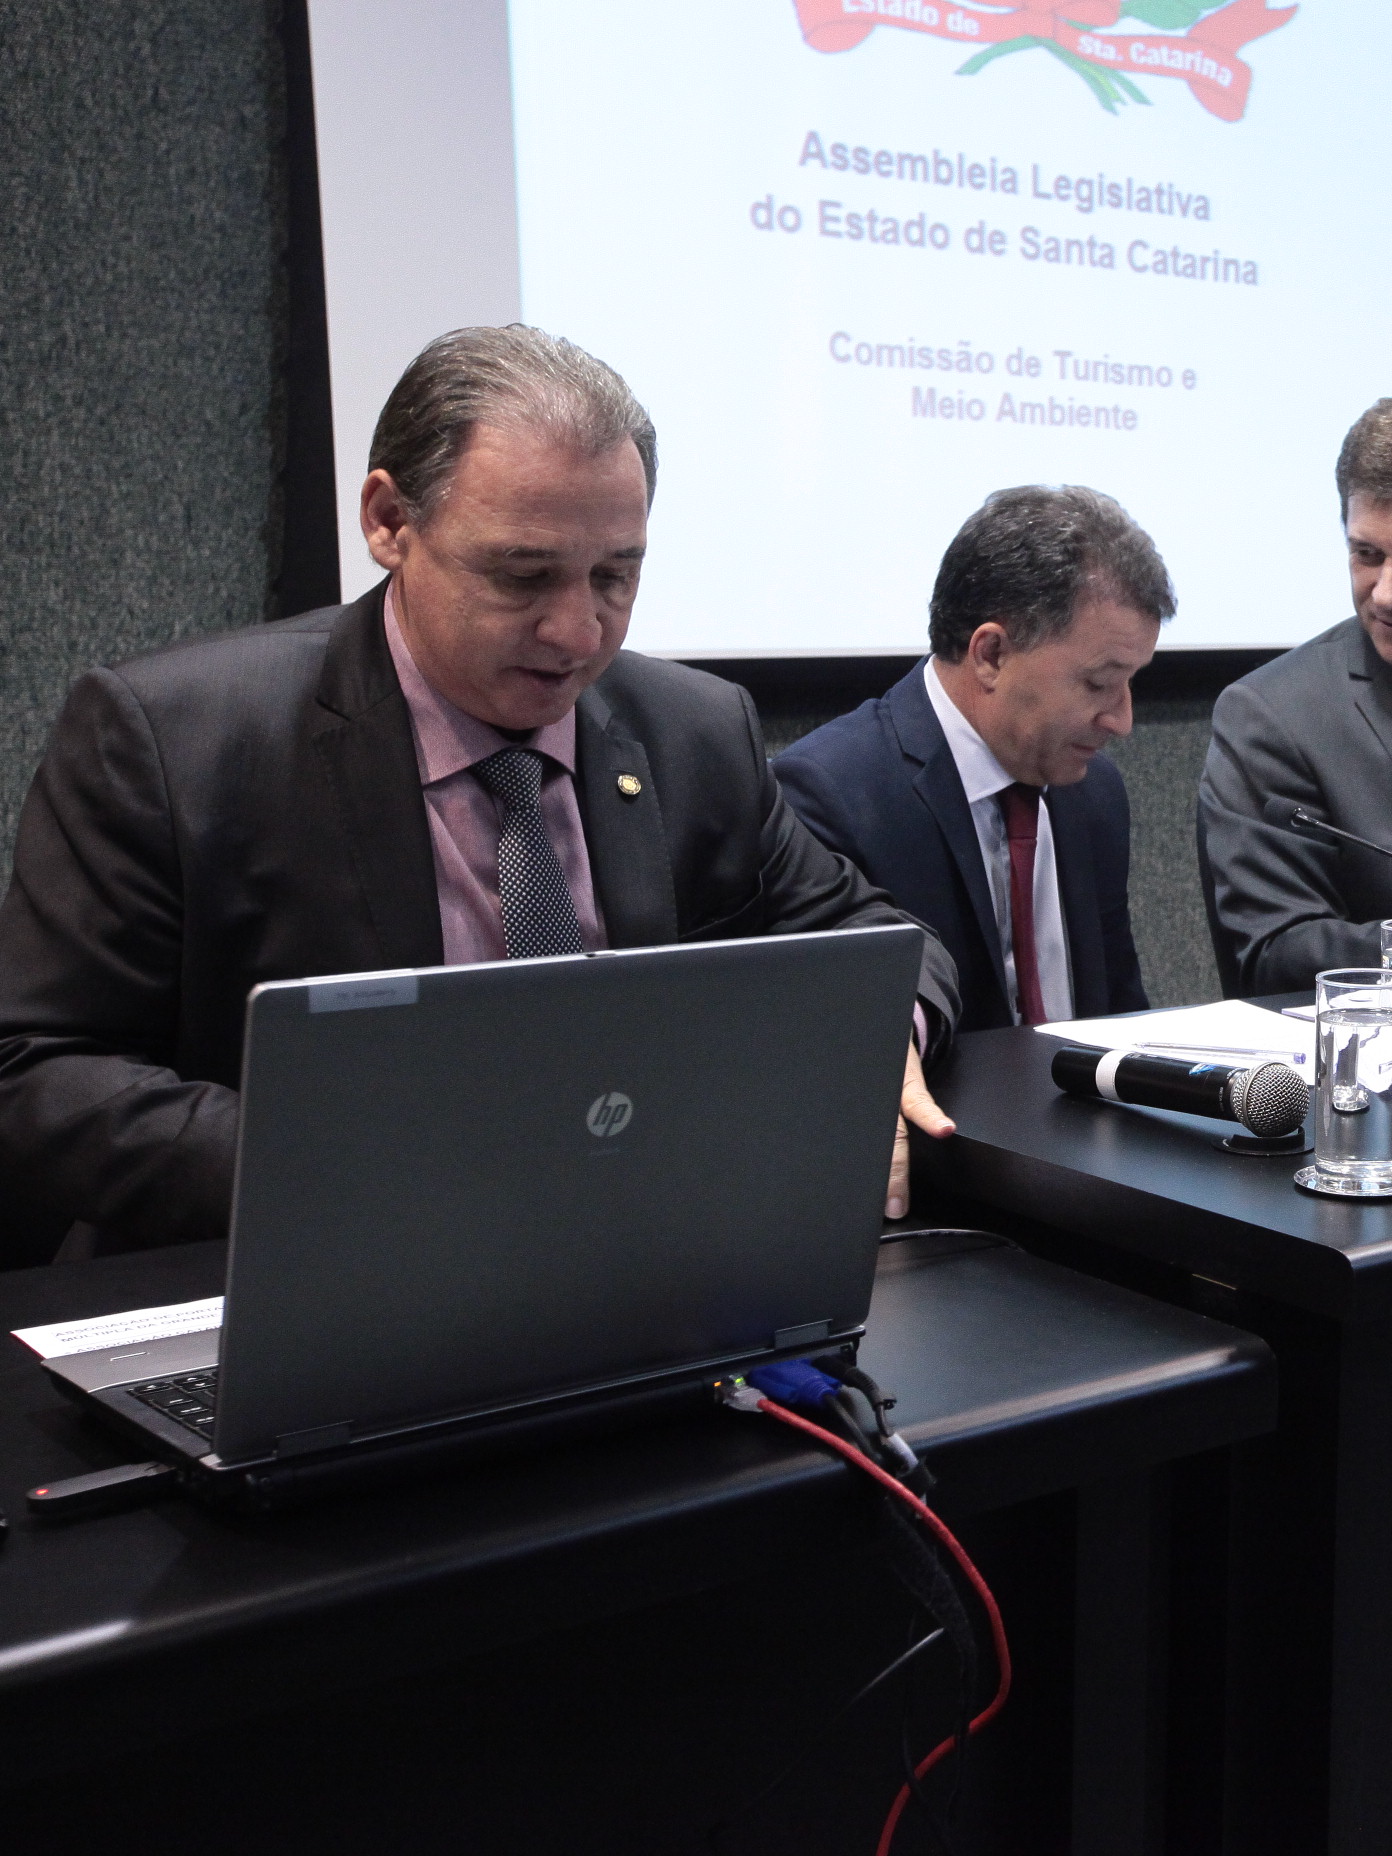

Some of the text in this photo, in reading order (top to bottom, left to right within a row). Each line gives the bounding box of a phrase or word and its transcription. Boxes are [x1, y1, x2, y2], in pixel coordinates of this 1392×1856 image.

[945, 10, 980, 36] de
[1078, 34, 1233, 88] Sta. Catarina
[799, 130, 1210, 221] Assembleia Legislativa
[750, 194, 1258, 286] do Estado de Santa Catarina
[829, 330, 1197, 390] Comissão de Turismo e
[912, 385, 1138, 431] Meio Ambiente
[590, 1092, 630, 1137] hp
